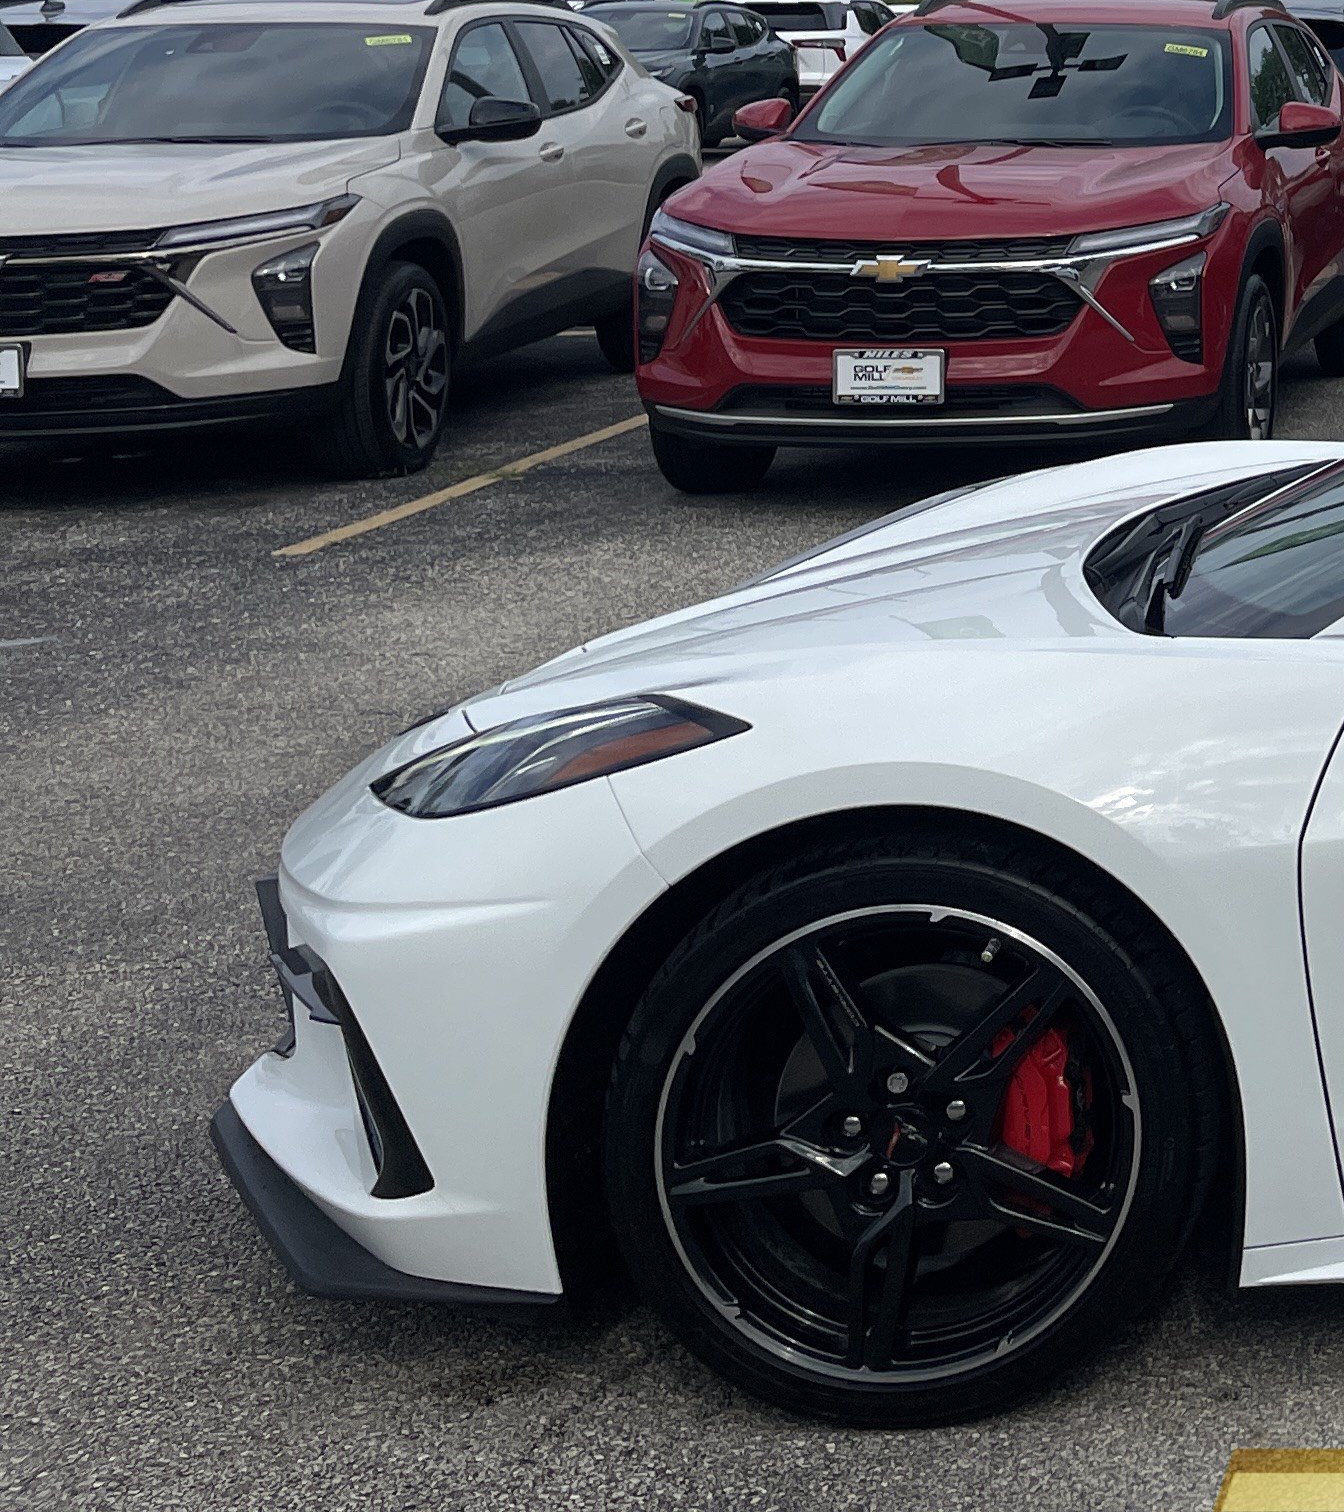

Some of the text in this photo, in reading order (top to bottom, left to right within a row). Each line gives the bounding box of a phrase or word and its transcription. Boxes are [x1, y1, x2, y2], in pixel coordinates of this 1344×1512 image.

[853, 364, 892, 374] GOLF
[853, 373, 885, 382] MILL
[860, 395, 917, 404] GOLF MILL
